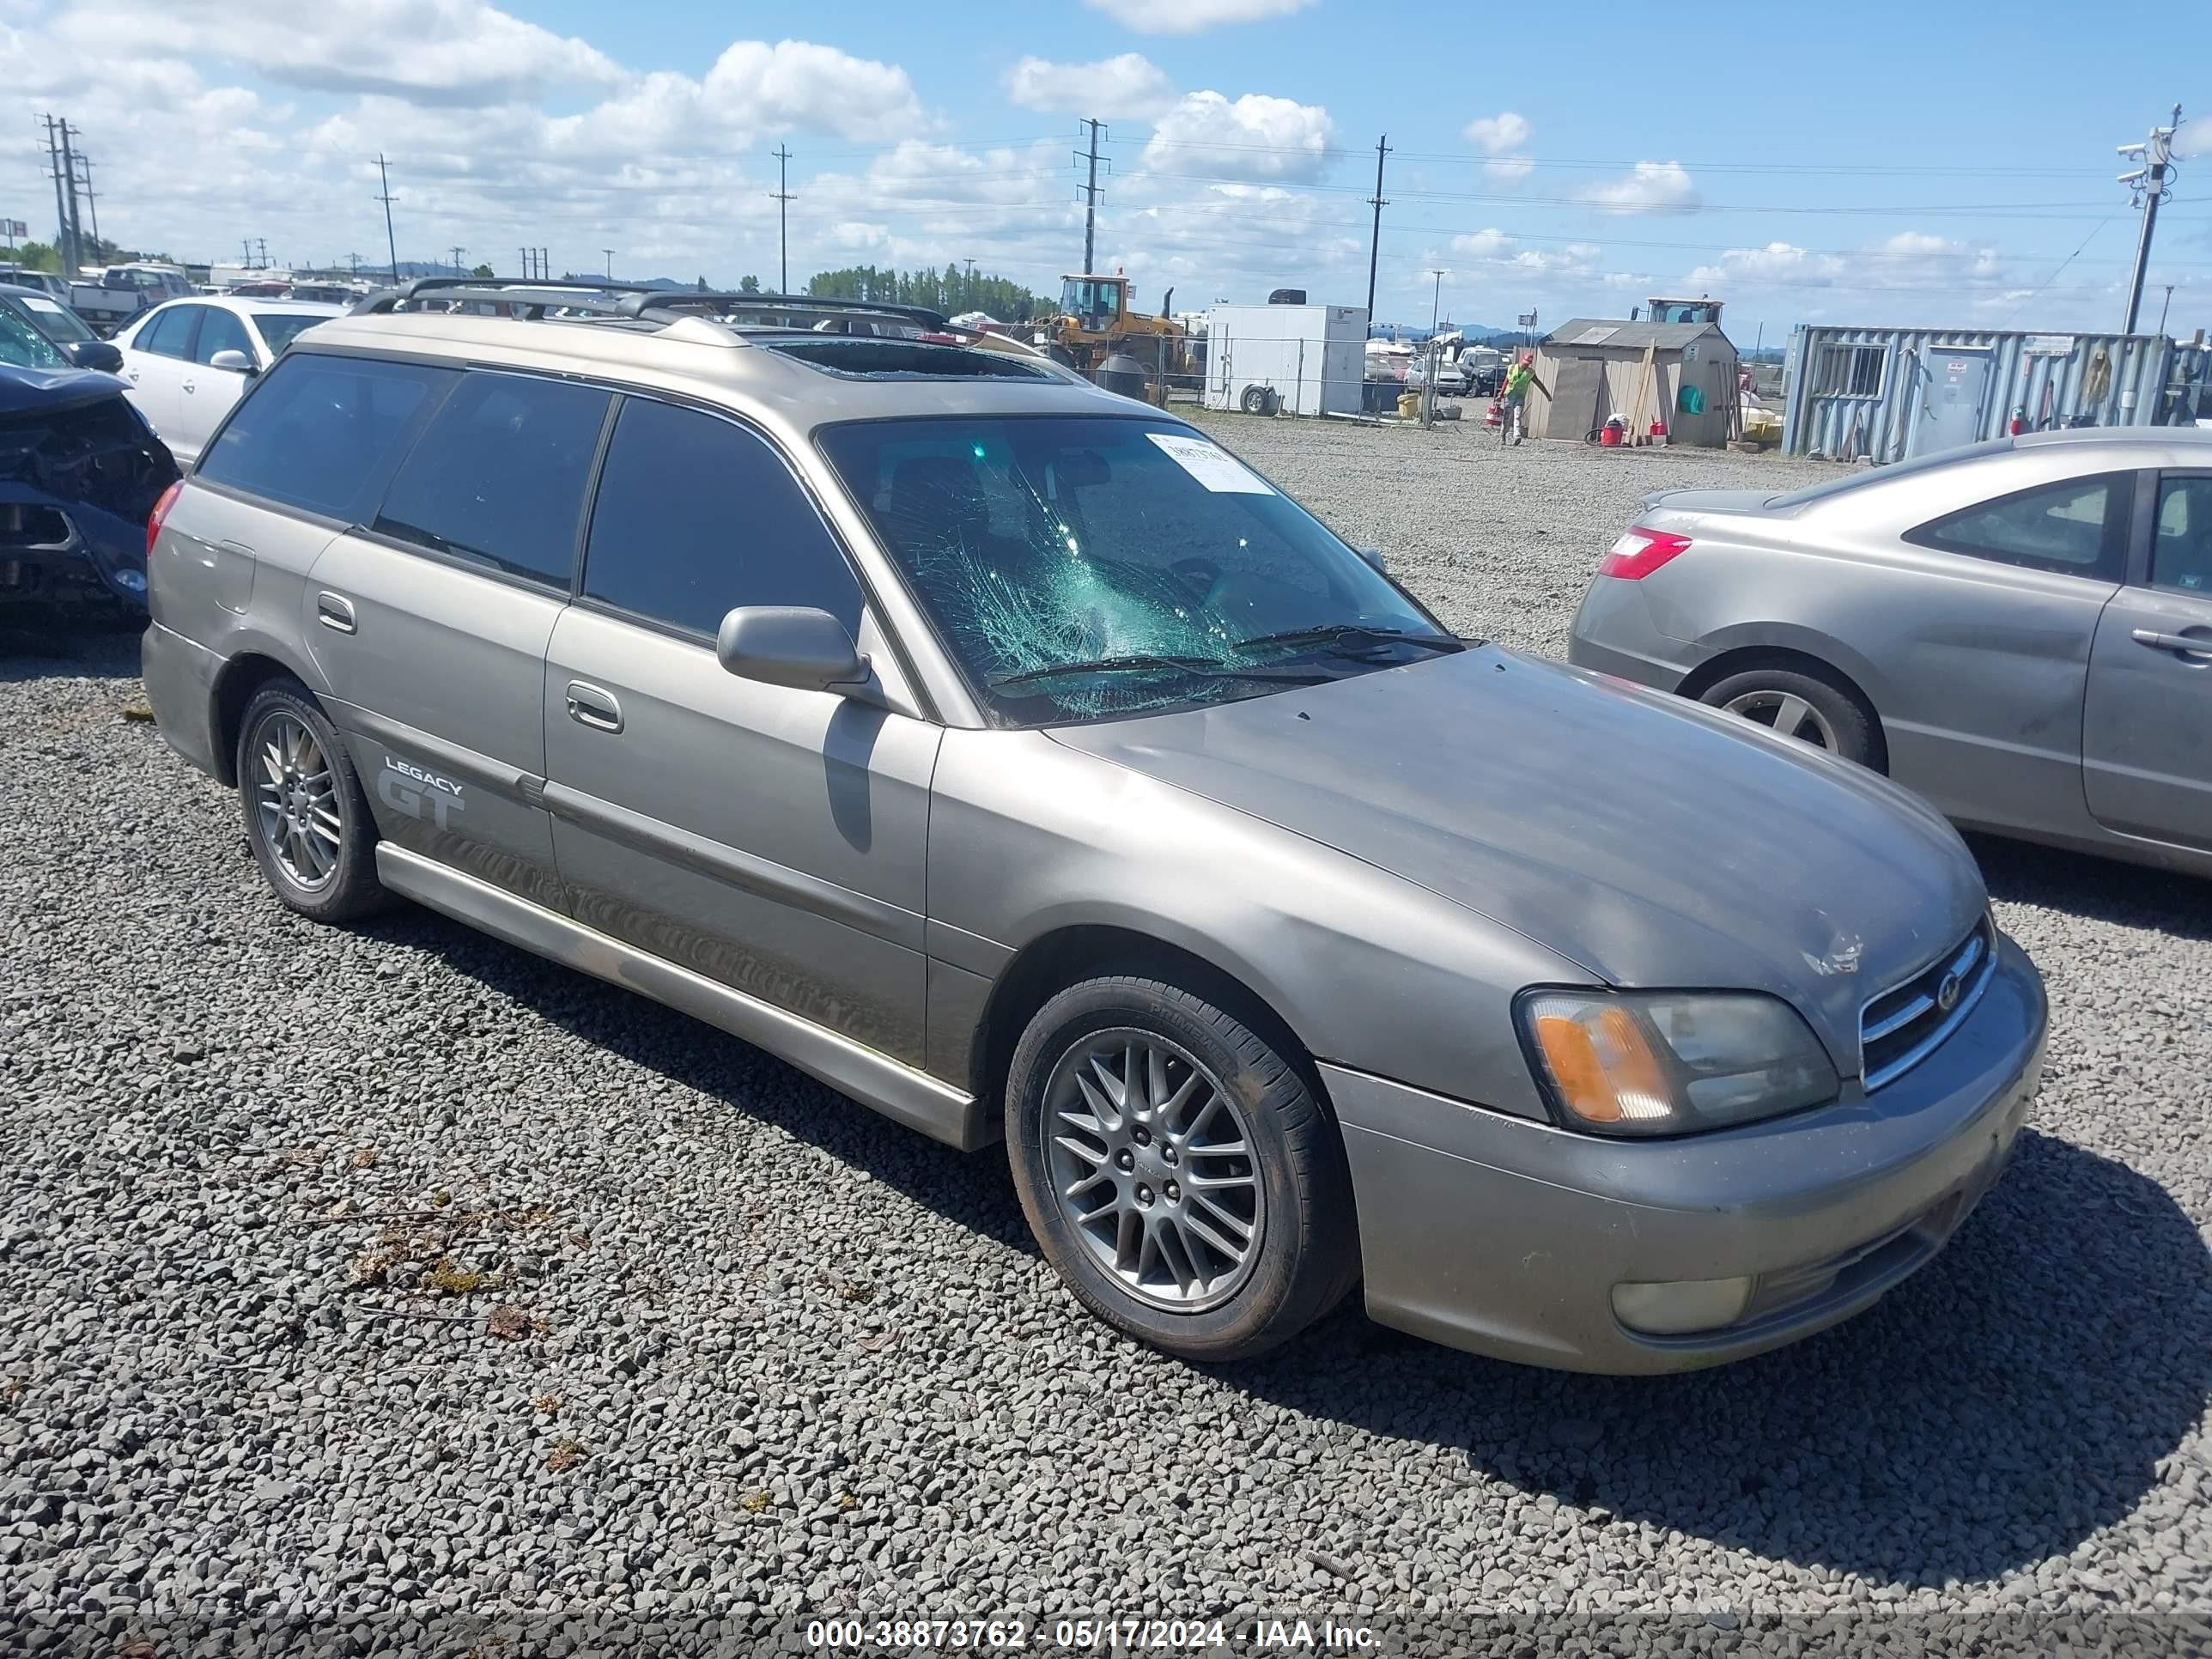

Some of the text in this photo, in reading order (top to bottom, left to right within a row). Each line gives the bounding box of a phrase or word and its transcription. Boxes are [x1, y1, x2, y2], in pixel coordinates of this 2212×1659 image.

[378, 769, 465, 831] GT
[385, 756, 463, 796] LEGACY
[1149, 1002, 1234, 1079] PRIMEWEL
